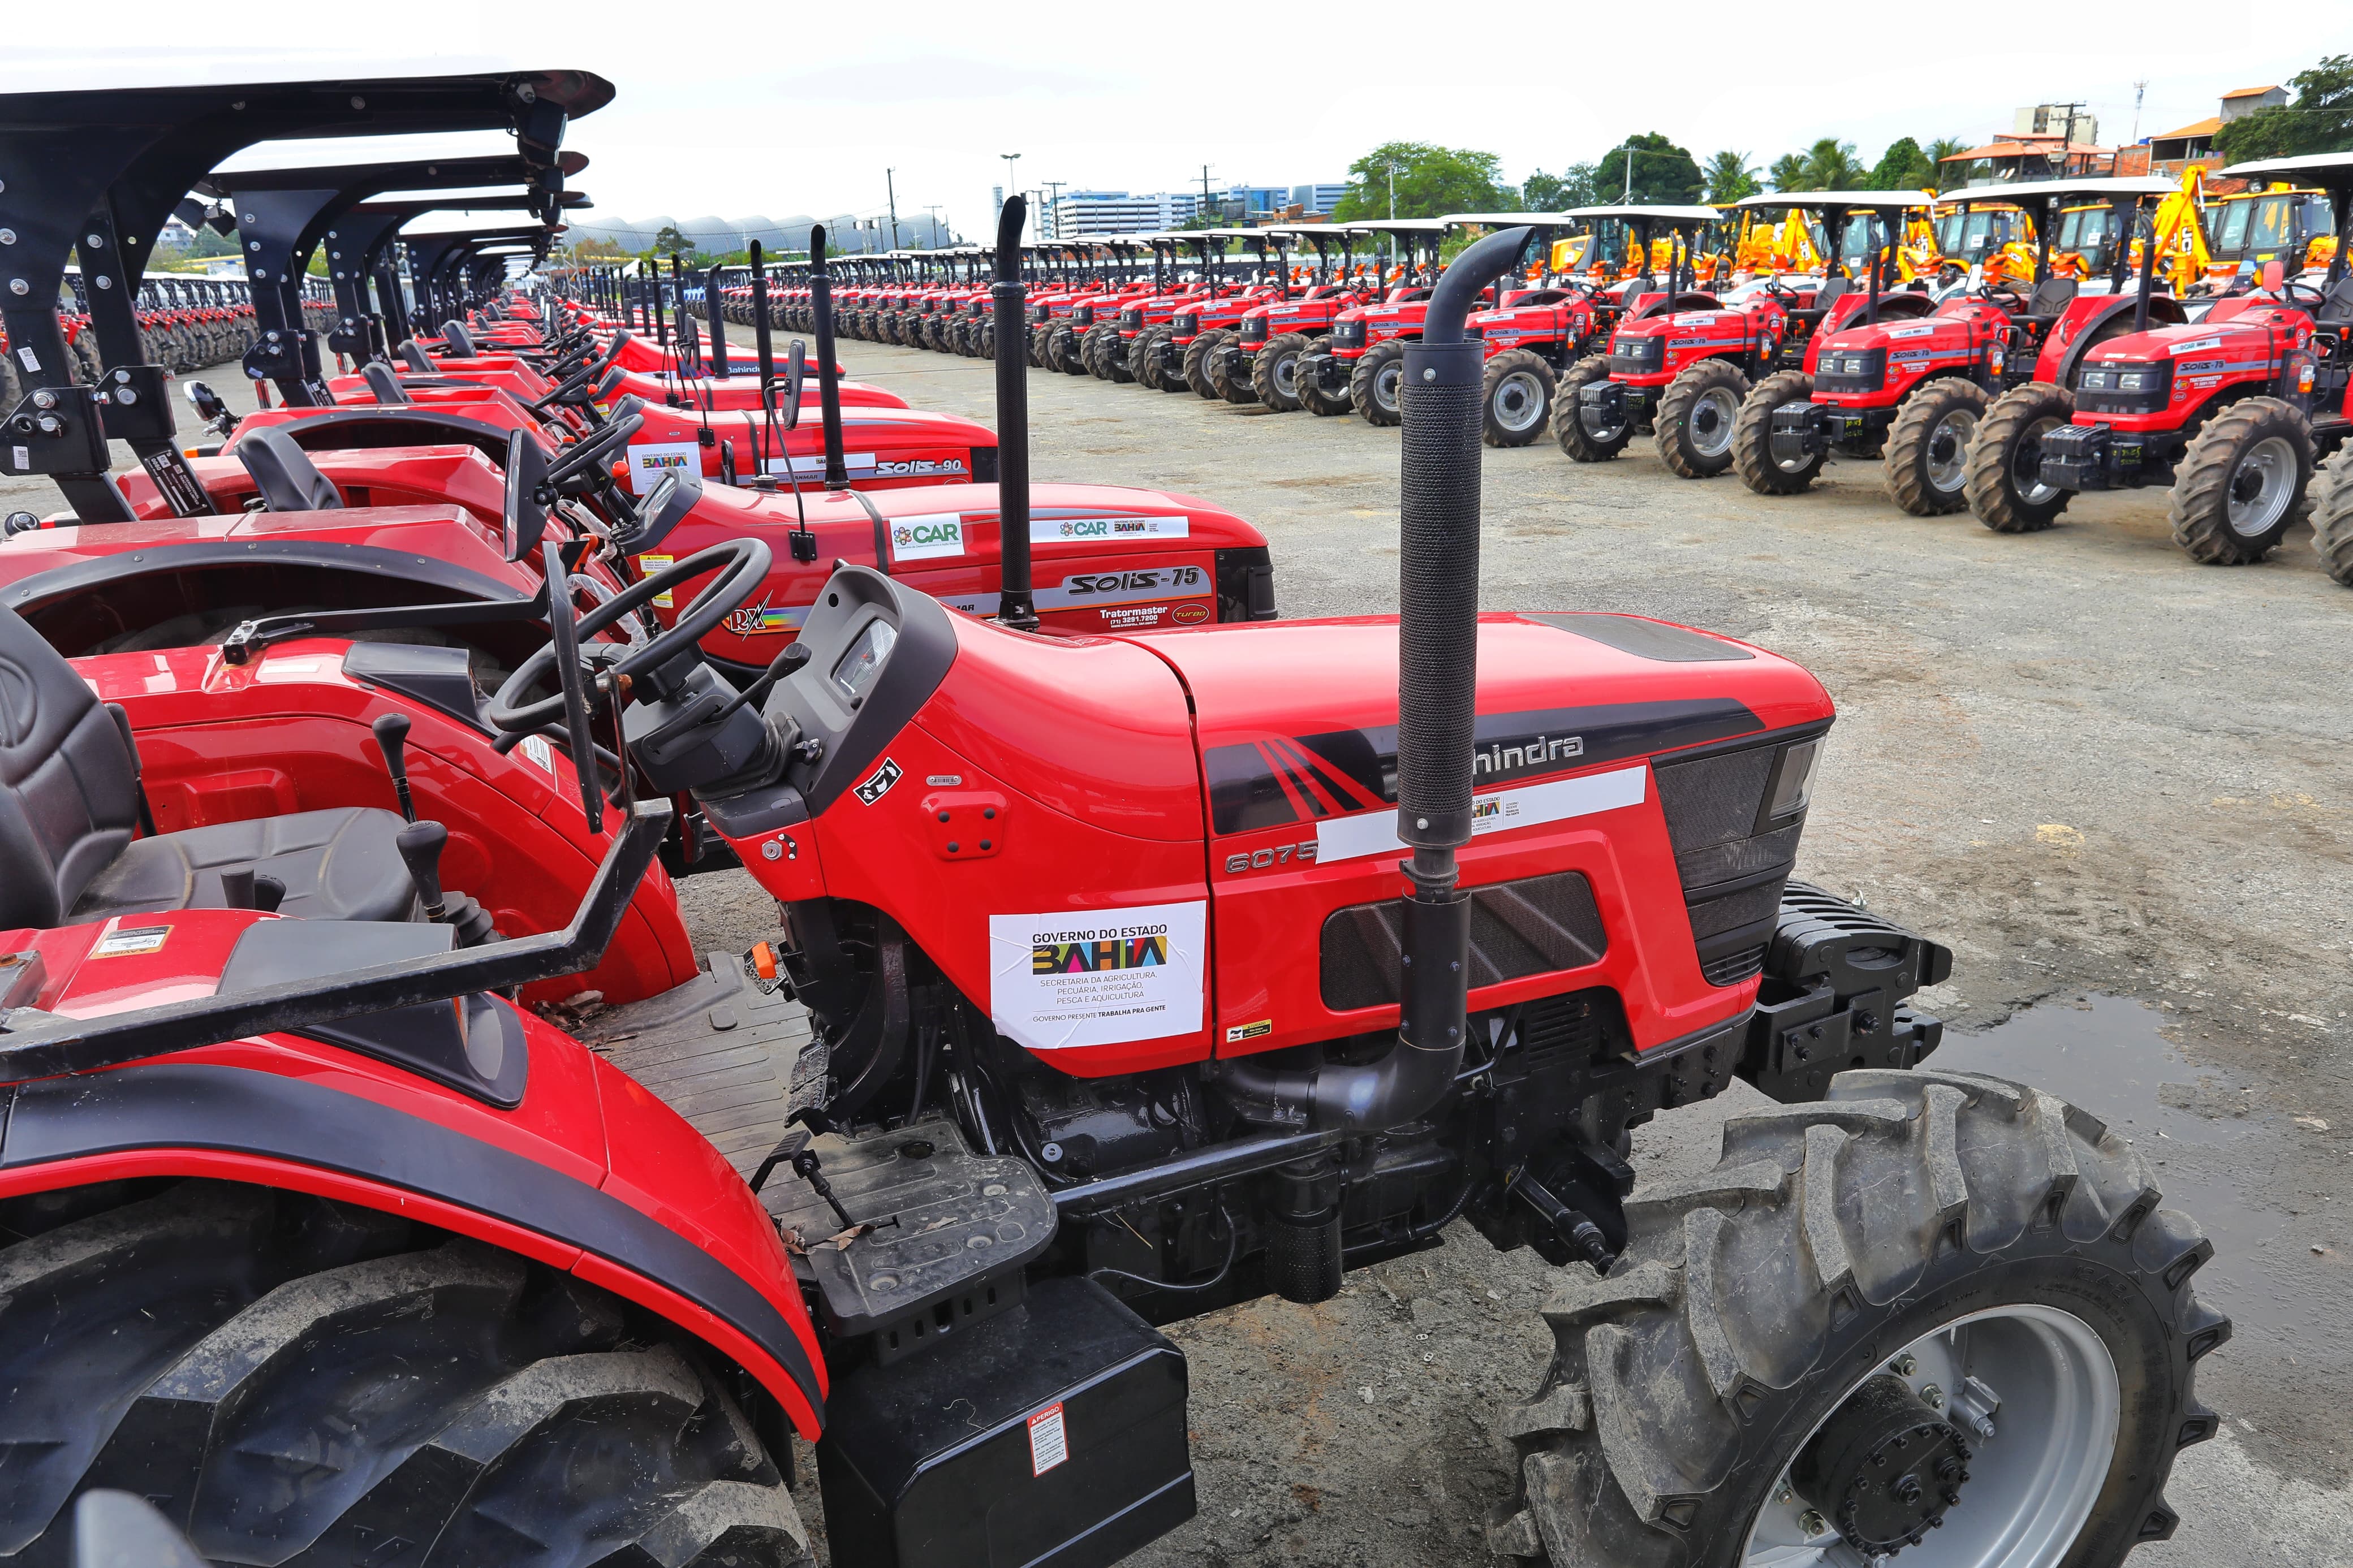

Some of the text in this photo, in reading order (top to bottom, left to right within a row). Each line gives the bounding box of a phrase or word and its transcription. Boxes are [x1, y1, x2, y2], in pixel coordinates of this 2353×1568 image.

[2007, 253, 2022, 263] JCB
[643, 456, 687, 468] BAHIA
[912, 524, 959, 543] CAR
[1075, 521, 1107, 535] CAR
[1114, 523, 1145, 532] BAHIA
[1100, 606, 1167, 619] Tratormaster
[1473, 736, 1584, 775] hindra
[1225, 840, 1318, 873] 6075
[1033, 925, 1167, 943] GOVERNO DO ESTADO
[1033, 936, 1167, 975] BAHIA
[1040, 974, 1089, 987] SECRETARIA
[1104, 971, 1157, 983] AGRICULTURA,
[1057, 981, 1144, 995] PECUÁRIA, IRRIGAÇÃO,
[1057, 996, 1083, 1004] PESCA
[1091, 991, 1144, 1002] AQUICULTURA
[1098, 1008, 1131, 1018] TRABALHA
[1036, 1406, 1059, 1422] PERIGO
